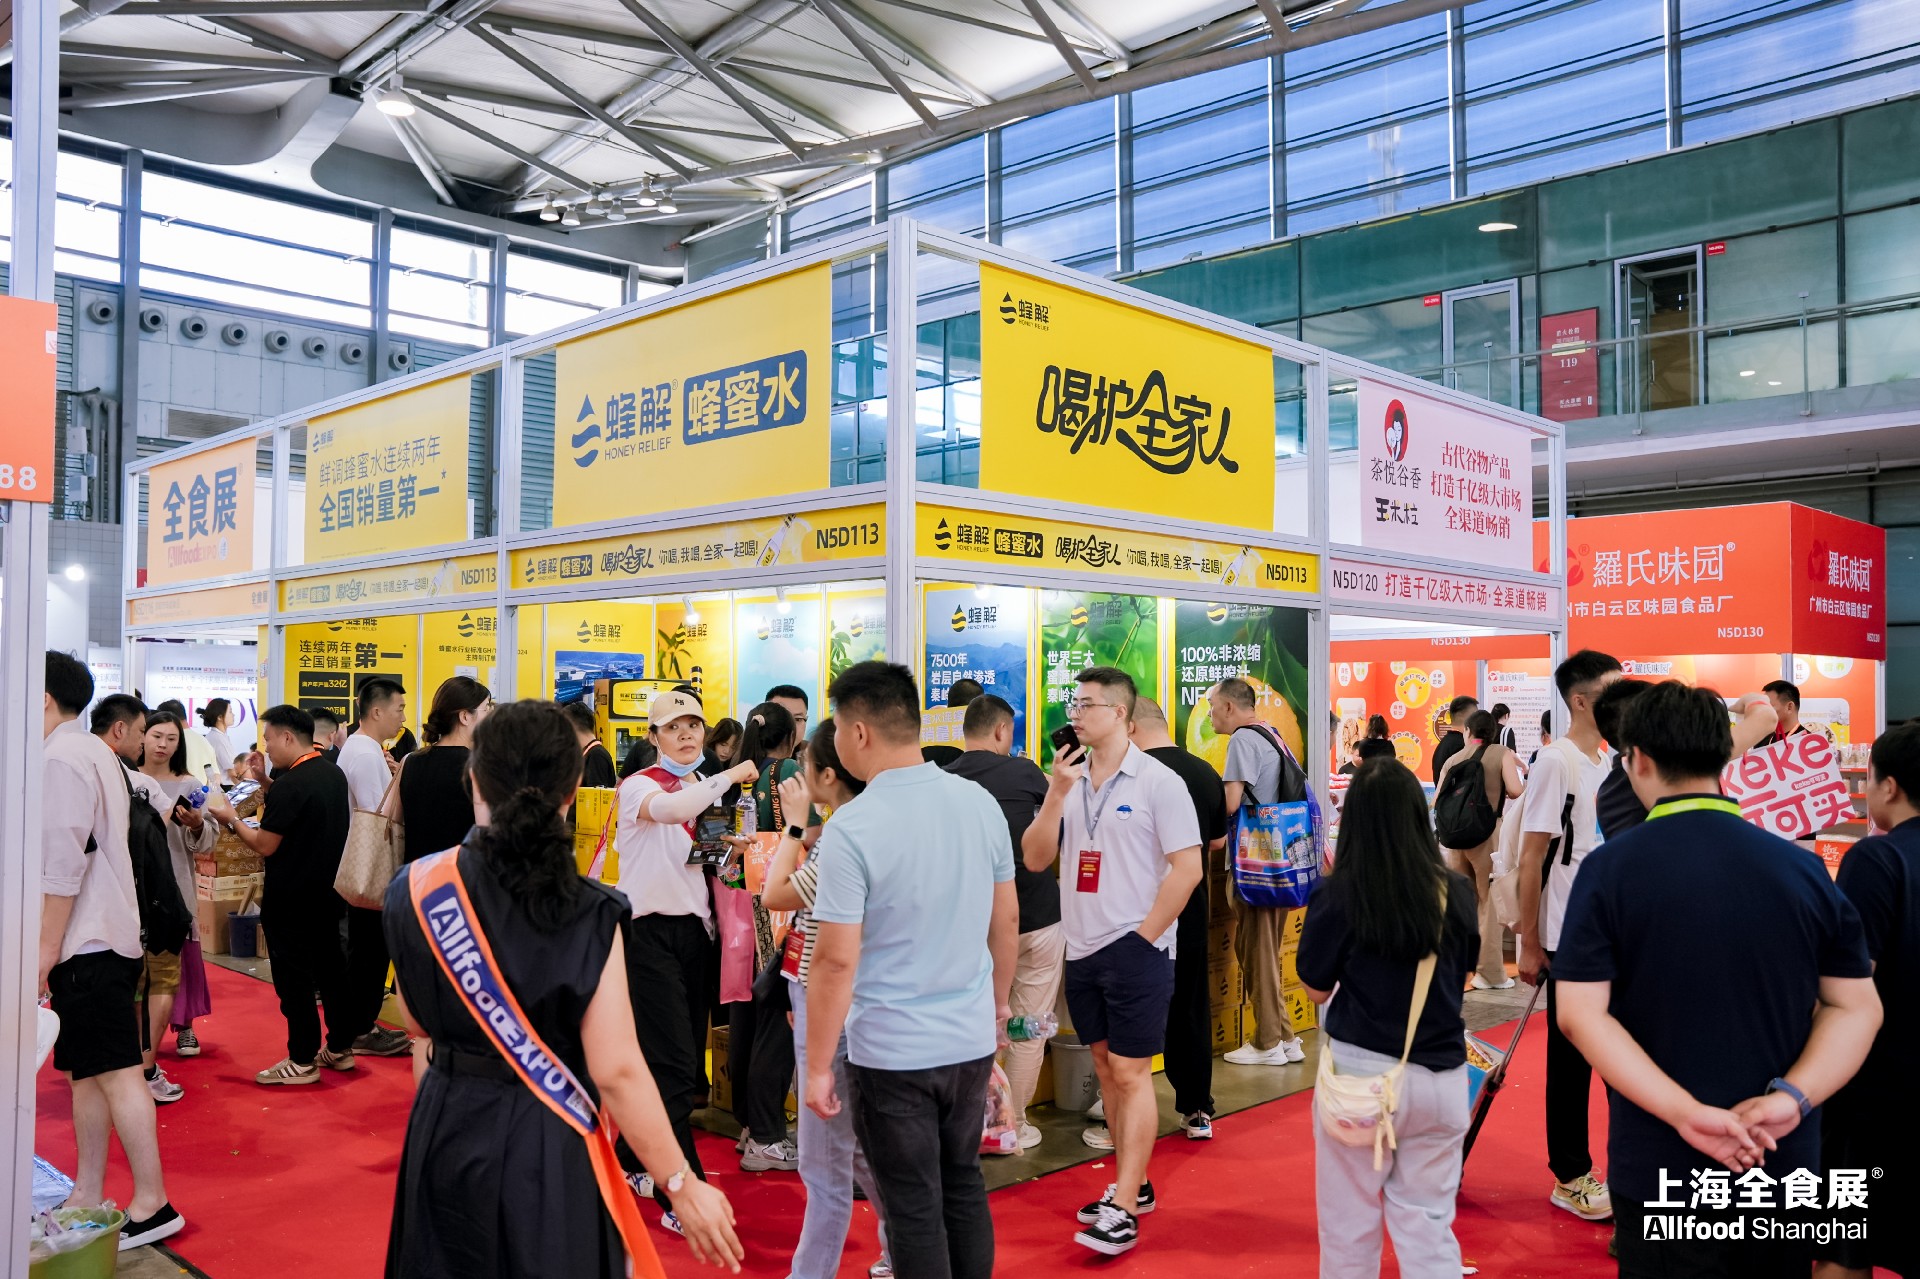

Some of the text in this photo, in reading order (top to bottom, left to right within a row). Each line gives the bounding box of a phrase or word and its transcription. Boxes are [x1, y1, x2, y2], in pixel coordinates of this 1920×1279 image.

[1018, 299, 1050, 324] 蜂解
[1560, 357, 1578, 368] 119
[605, 362, 801, 443] 蜂解 蜂蜜水
[1036, 364, 1240, 475] 喝护全家人
[604, 436, 672, 461] HONEY RELIEF
[319, 435, 441, 487] 鲜调蜂蜜水连续两年
[1371, 457, 1422, 489] 茶悦谷香
[1442, 442, 1511, 481] 古代谷物产品
[1431, 471, 1522, 512] 打造千亿级大市场
[163, 467, 237, 543] 全食展
[1444, 506, 1511, 539] 全渠道畅销
[537, 557, 558, 575] 蜂解
[560, 556, 592, 577] 蜂蜜水
[601, 544, 654, 575] 喝护全家人
[816, 523, 880, 550] N5D113
[956, 523, 990, 546] 蜂解
[995, 529, 1042, 558] 蜂蜜水
[1055, 534, 1122, 568] 喝护全家人
[1266, 563, 1307, 583] N5D113
[461, 567, 497, 586] N5D113
[1333, 568, 1378, 592] N5D120
[968, 606, 997, 624] 蜂解
[593, 623, 621, 638] 蜂解
[1430, 636, 1471, 646] N5D130
[1717, 627, 1764, 638] N5D130
[299, 640, 352, 654] 连续两年
[354, 642, 404, 668] 第一
[1047, 650, 1095, 667] 世界三大
[1181, 644, 1262, 663] 100%非浓缩
[299, 654, 352, 670] 全国销量
[931, 652, 968, 668] 7500年
[1181, 664, 1251, 683] 还原鲜榨汁
[1258, 806, 1280, 819] NFC
